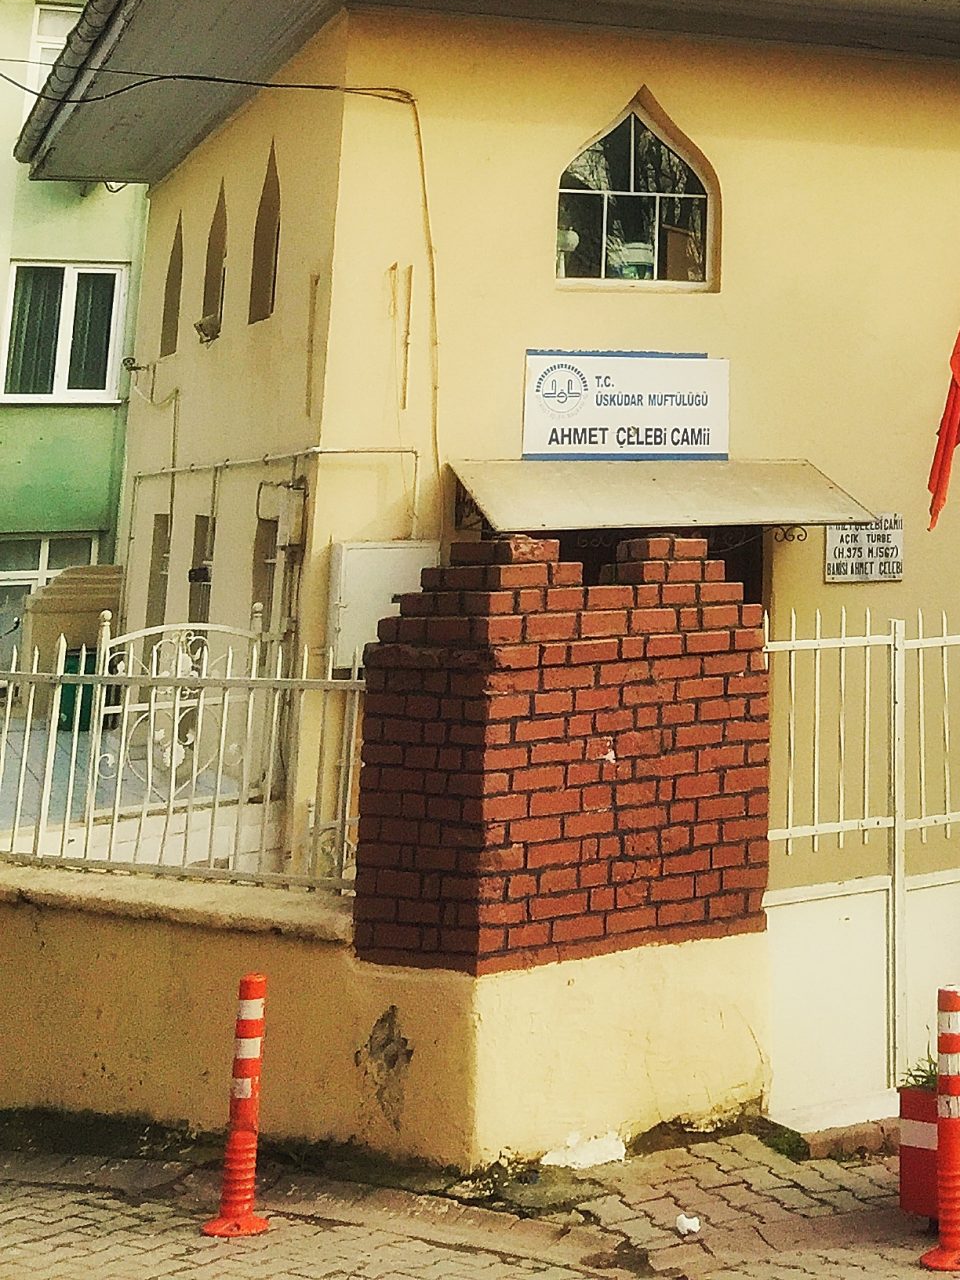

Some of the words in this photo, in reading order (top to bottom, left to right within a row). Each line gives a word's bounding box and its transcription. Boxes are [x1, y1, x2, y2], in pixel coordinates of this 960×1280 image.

[595, 376, 615, 388] T.C.
[595, 391, 643, 406] ÜSKÜDAR
[548, 427, 609, 445] AHMET
[850, 561, 874, 575] AHMET
